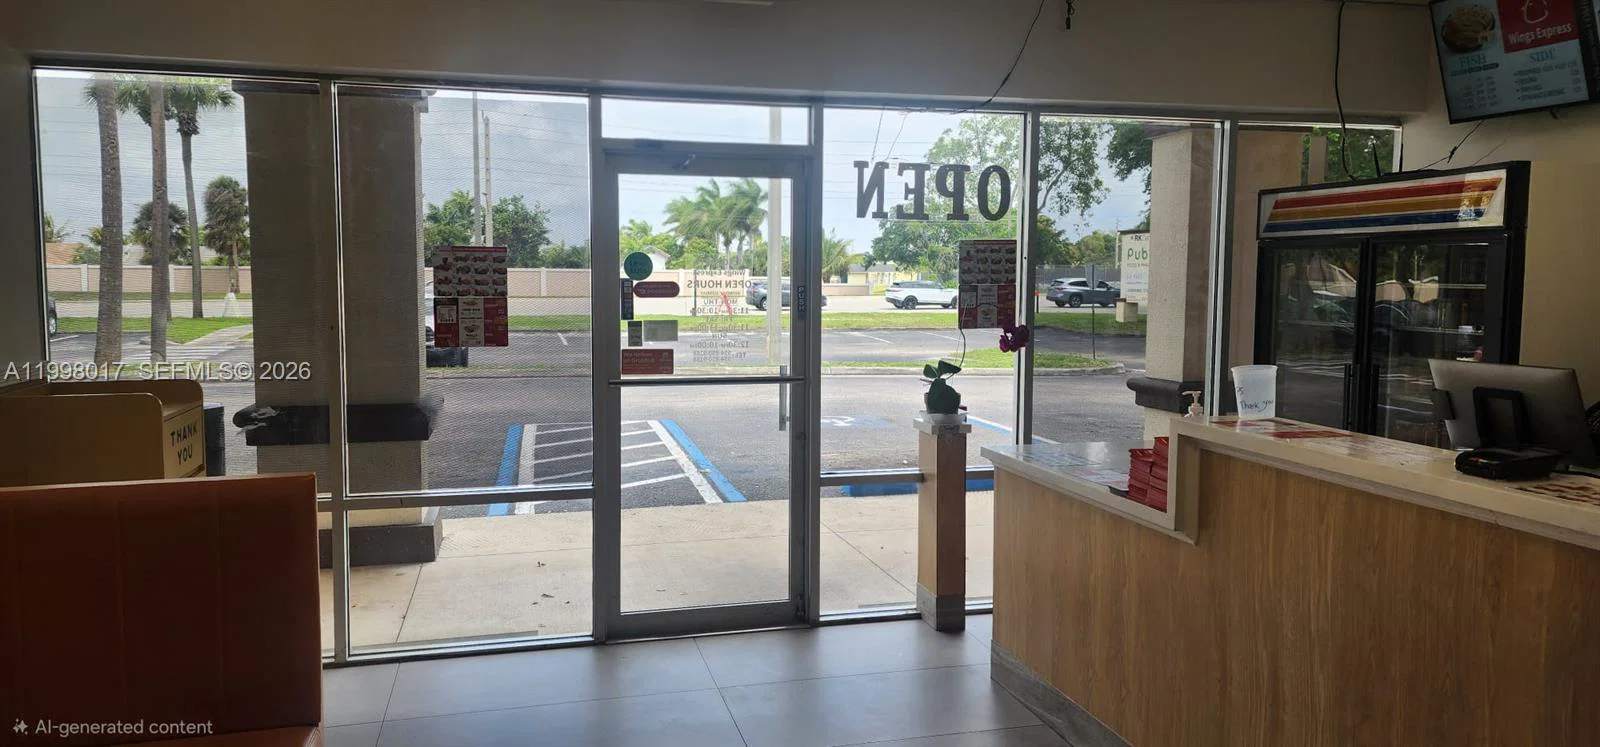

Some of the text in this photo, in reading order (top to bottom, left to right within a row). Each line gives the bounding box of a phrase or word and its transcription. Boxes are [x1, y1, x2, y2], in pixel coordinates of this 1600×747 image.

[1508, 23, 1572, 44] Wings Express
[170, 422, 198, 447] THANK
[177, 444, 192, 465] YOU
